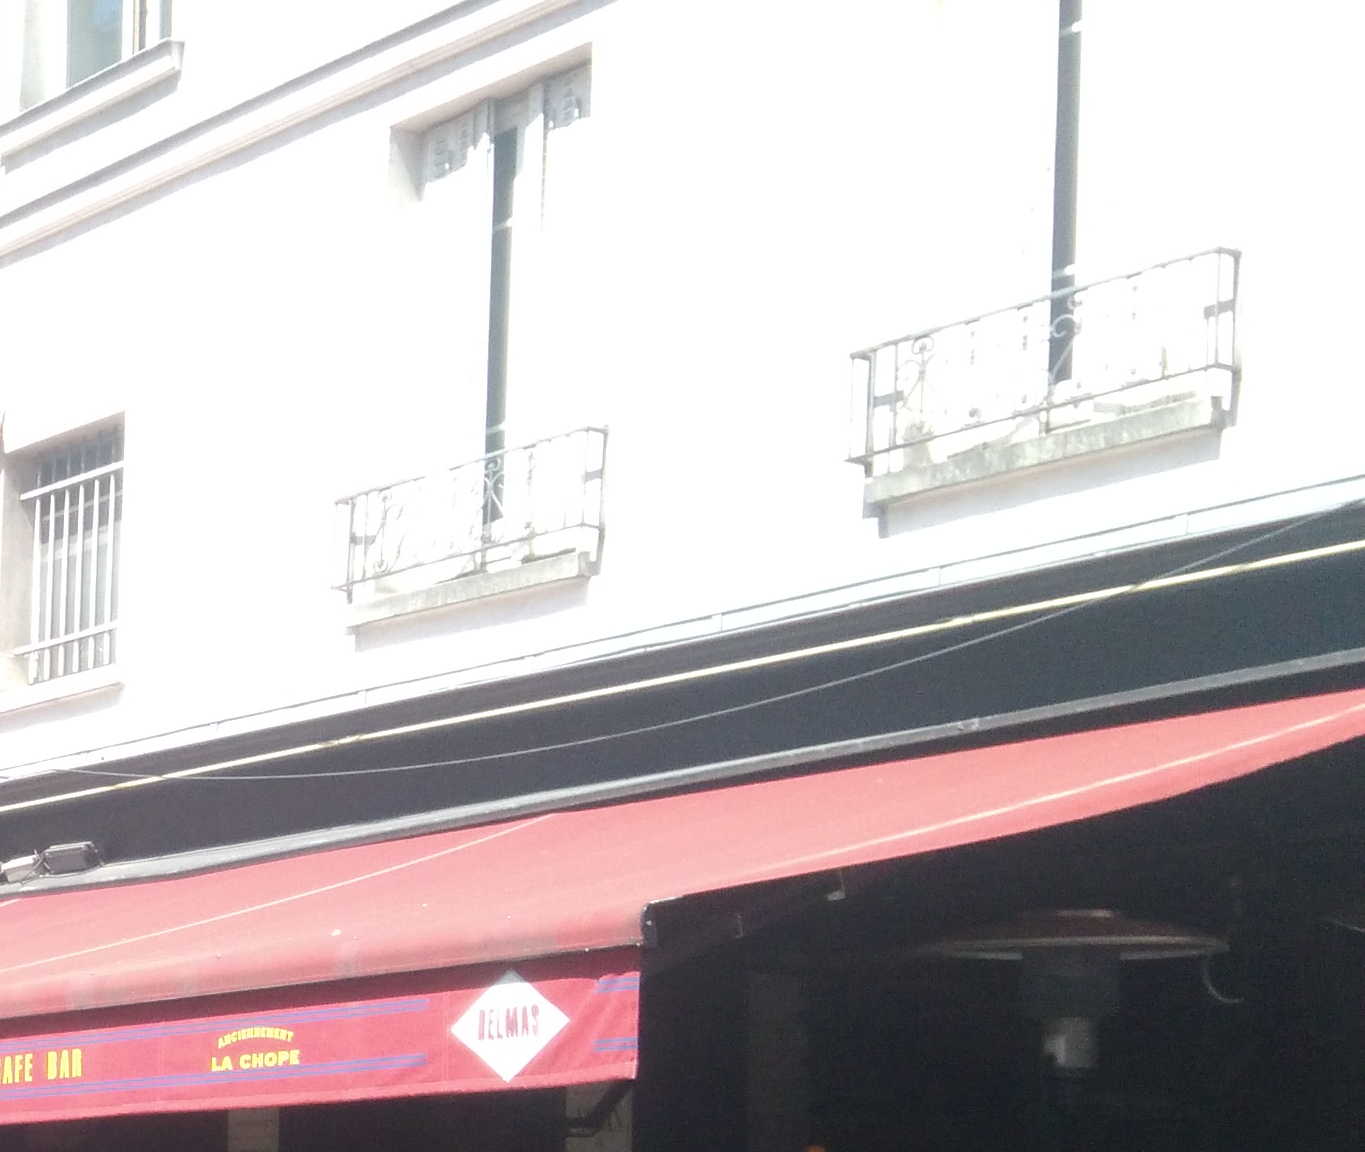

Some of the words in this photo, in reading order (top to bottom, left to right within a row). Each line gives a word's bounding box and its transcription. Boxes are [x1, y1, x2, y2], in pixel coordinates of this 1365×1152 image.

[477, 1004, 540, 1041] DELMAS
[46, 1047, 83, 1080] BAR
[211, 1056, 233, 1072] LA
[239, 1049, 300, 1070] CHOPE
